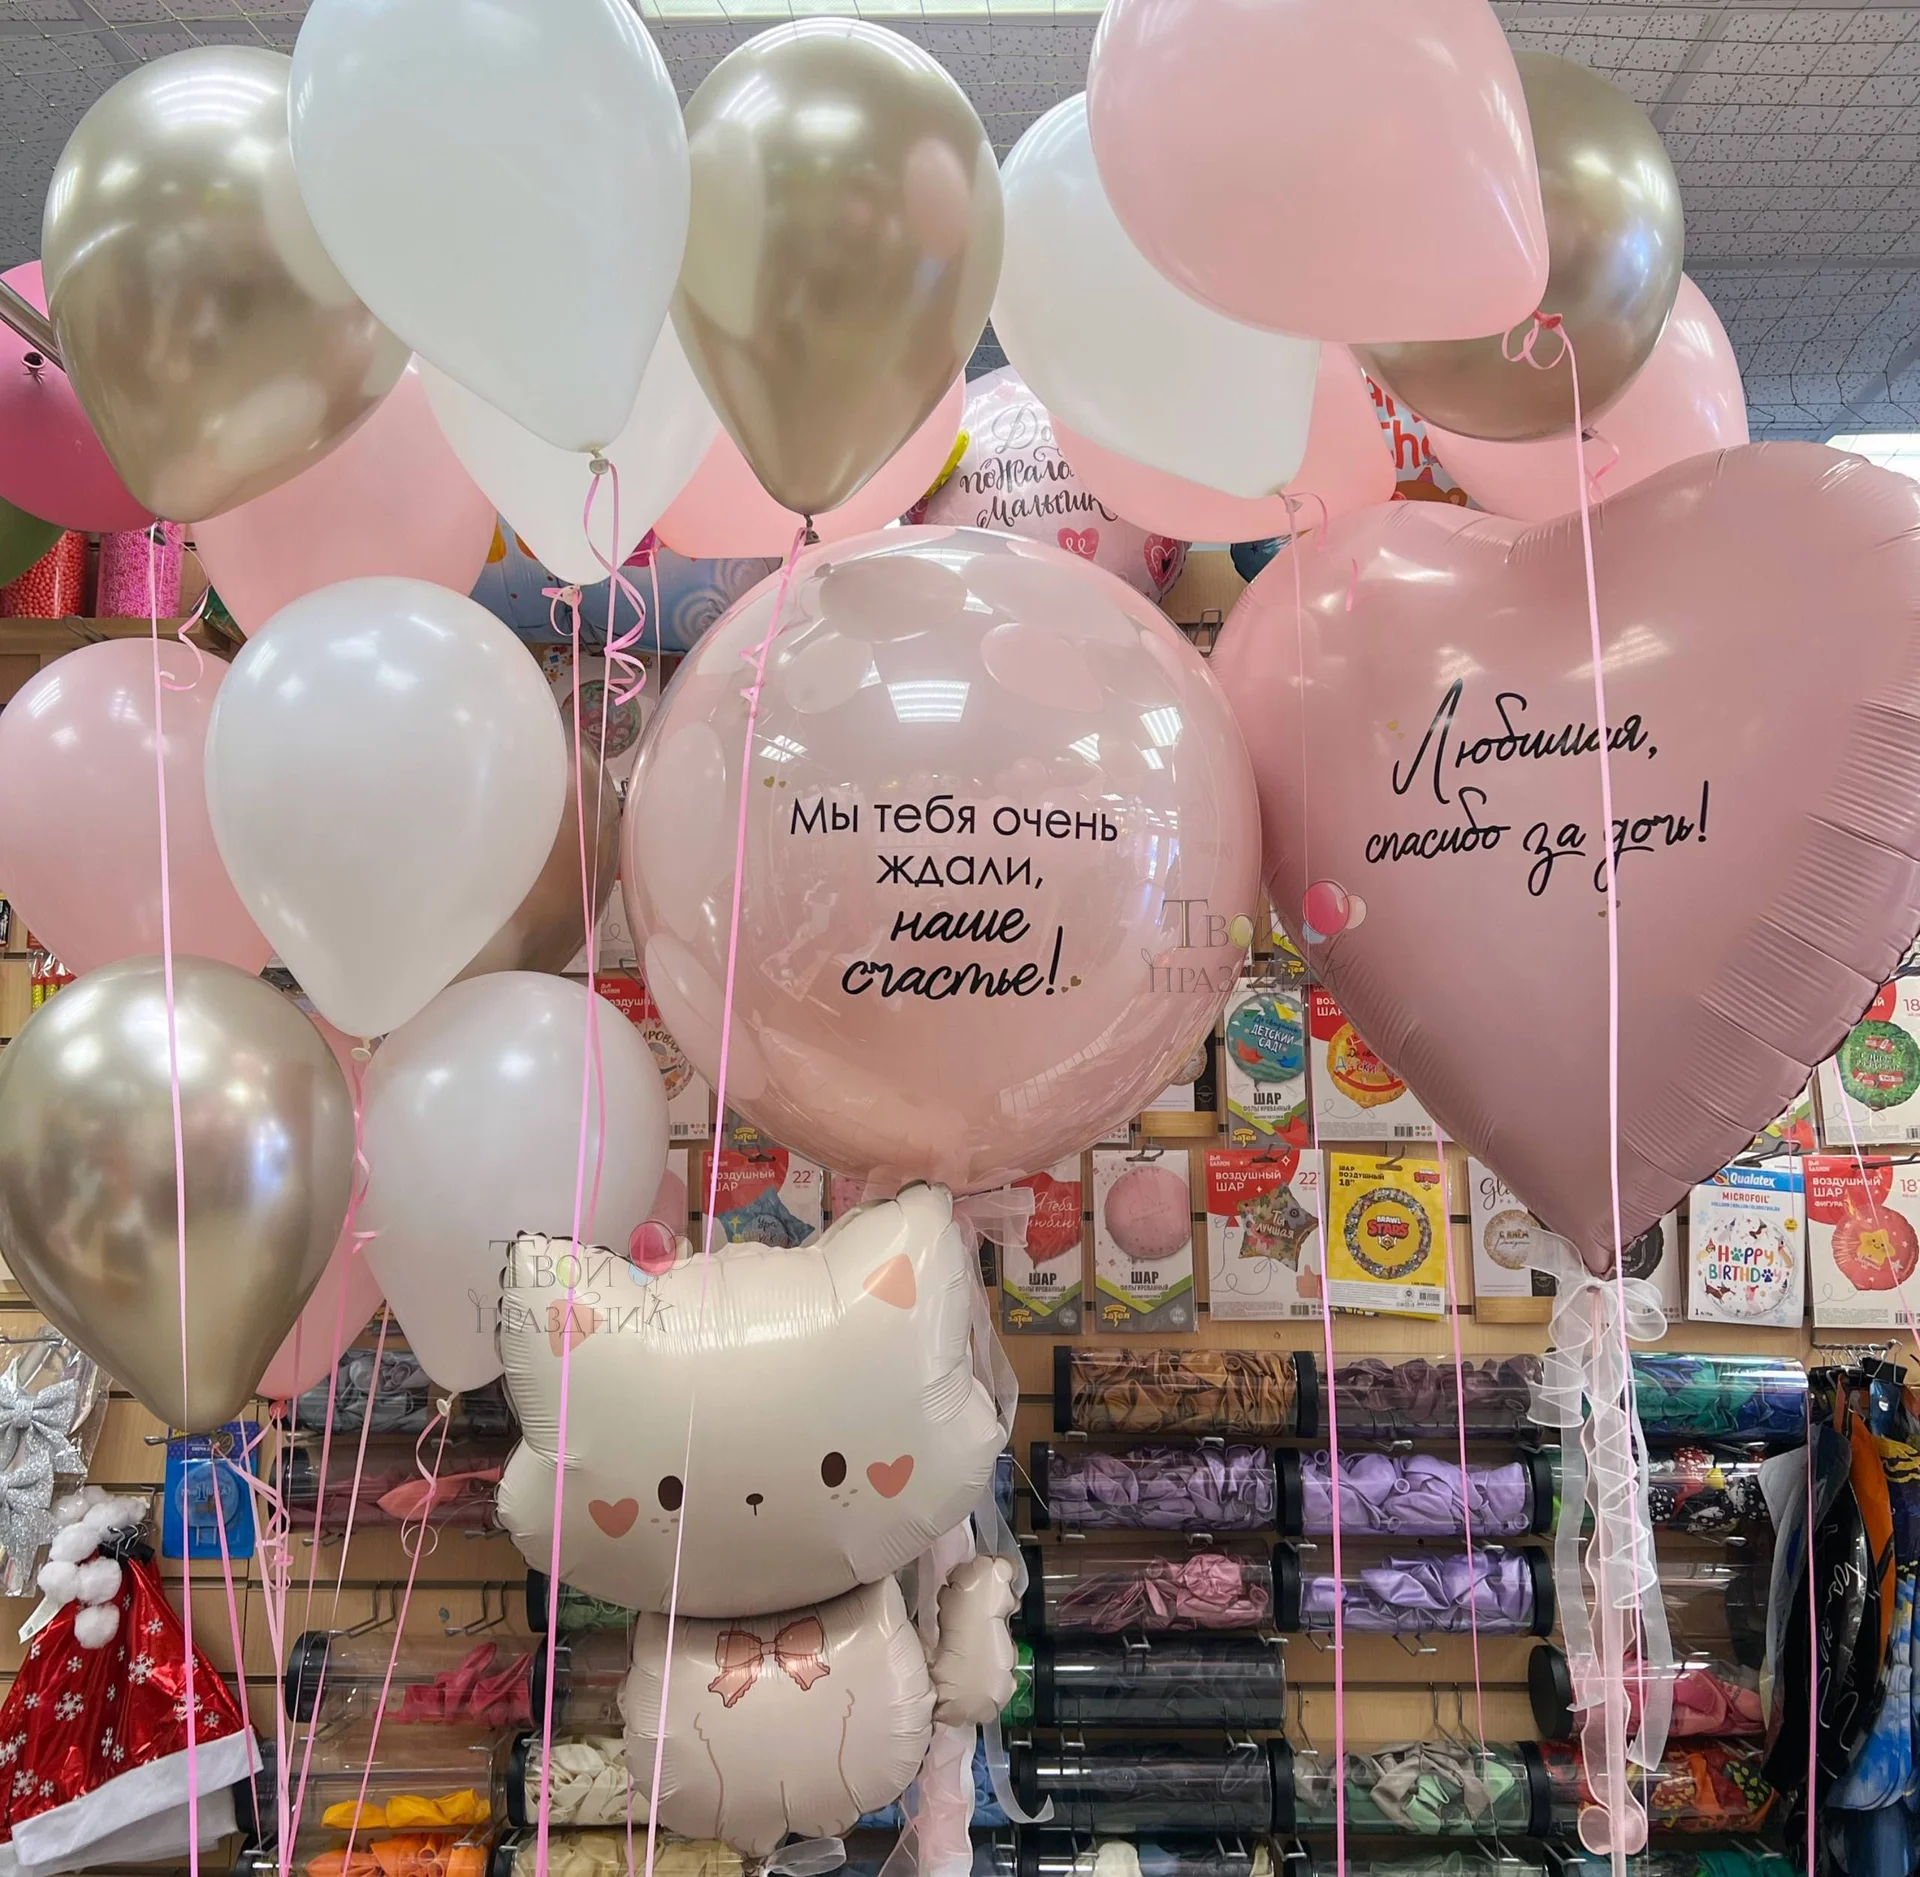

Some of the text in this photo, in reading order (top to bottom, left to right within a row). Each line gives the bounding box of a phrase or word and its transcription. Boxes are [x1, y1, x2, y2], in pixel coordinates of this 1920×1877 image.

[1392, 677, 1658, 805] Любимая,
[790, 794, 1118, 842] Мы тебя очень
[1365, 779, 1710, 897] спасибо за дочь!
[875, 854, 1044, 890] ждали,
[889, 907, 1031, 944] наше
[841, 925, 1063, 1001] счастье!
[1258, 1036, 1283, 1054] САД!
[1253, 1092, 1282, 1105] ШАР
[1215, 1170, 1282, 1182] воздушный
[1338, 1171, 1385, 1181] ВОЗДУШНЫЙ
[1730, 1172, 1776, 1188] Qualatex
[1216, 1182, 1245, 1192] ШАР
[1813, 1187, 1843, 1197] ШАР
[1271, 1209, 1286, 1226] Ты
[1376, 1215, 1402, 1224] BRAWL
[1256, 1222, 1296, 1239] лучшая
[1367, 1220, 1410, 1239] STARS
[1028, 1272, 1057, 1286] ШАР
[1130, 1271, 1159, 1284] ШАР
